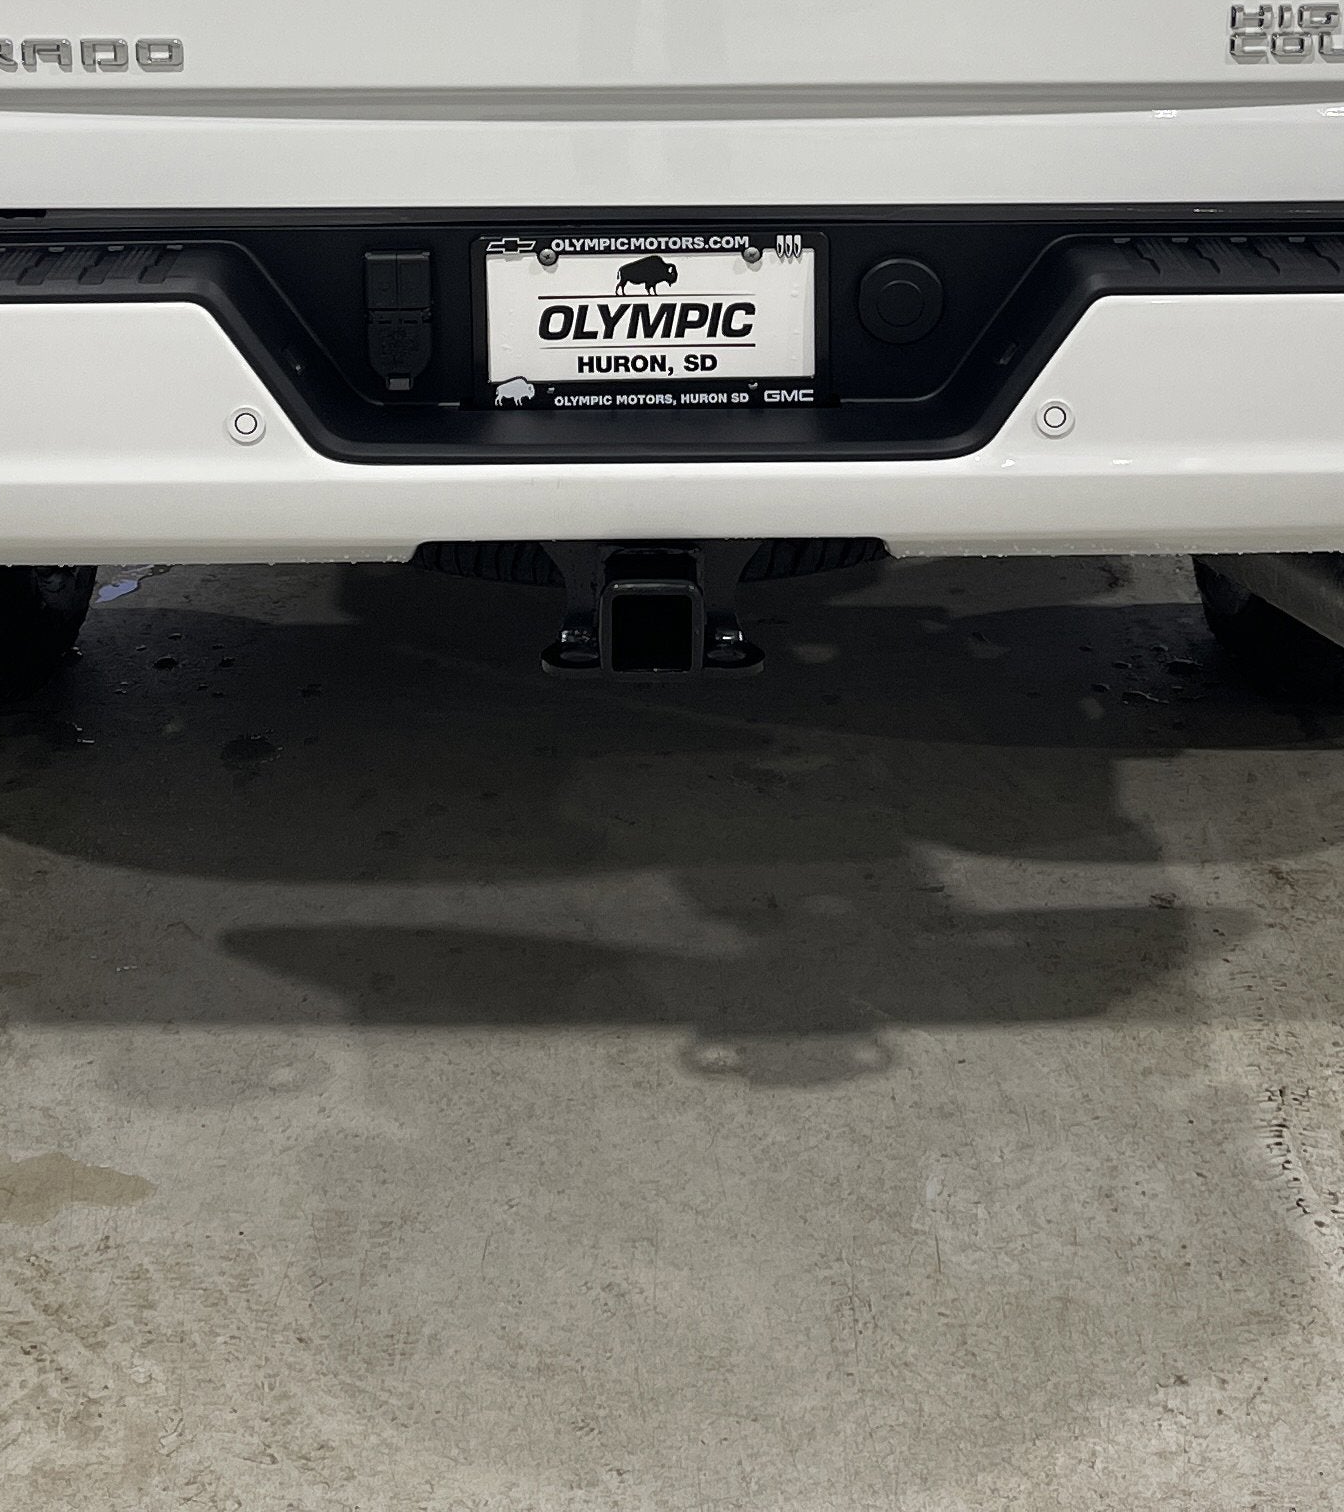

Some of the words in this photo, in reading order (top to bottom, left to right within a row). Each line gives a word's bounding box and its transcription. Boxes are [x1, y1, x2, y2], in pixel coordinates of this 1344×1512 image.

[551, 235, 749, 252] OLYMPICMOTORS.COM
[538, 302, 756, 340] OLYMPIC
[577, 354, 674, 375] HURON,
[684, 353, 718, 372] SD
[554, 394, 612, 406] OLYMPIC
[616, 393, 677, 406] MOTORS,
[680, 393, 727, 404] HURON
[731, 392, 749, 403] SD
[764, 389, 814, 402] GMC
